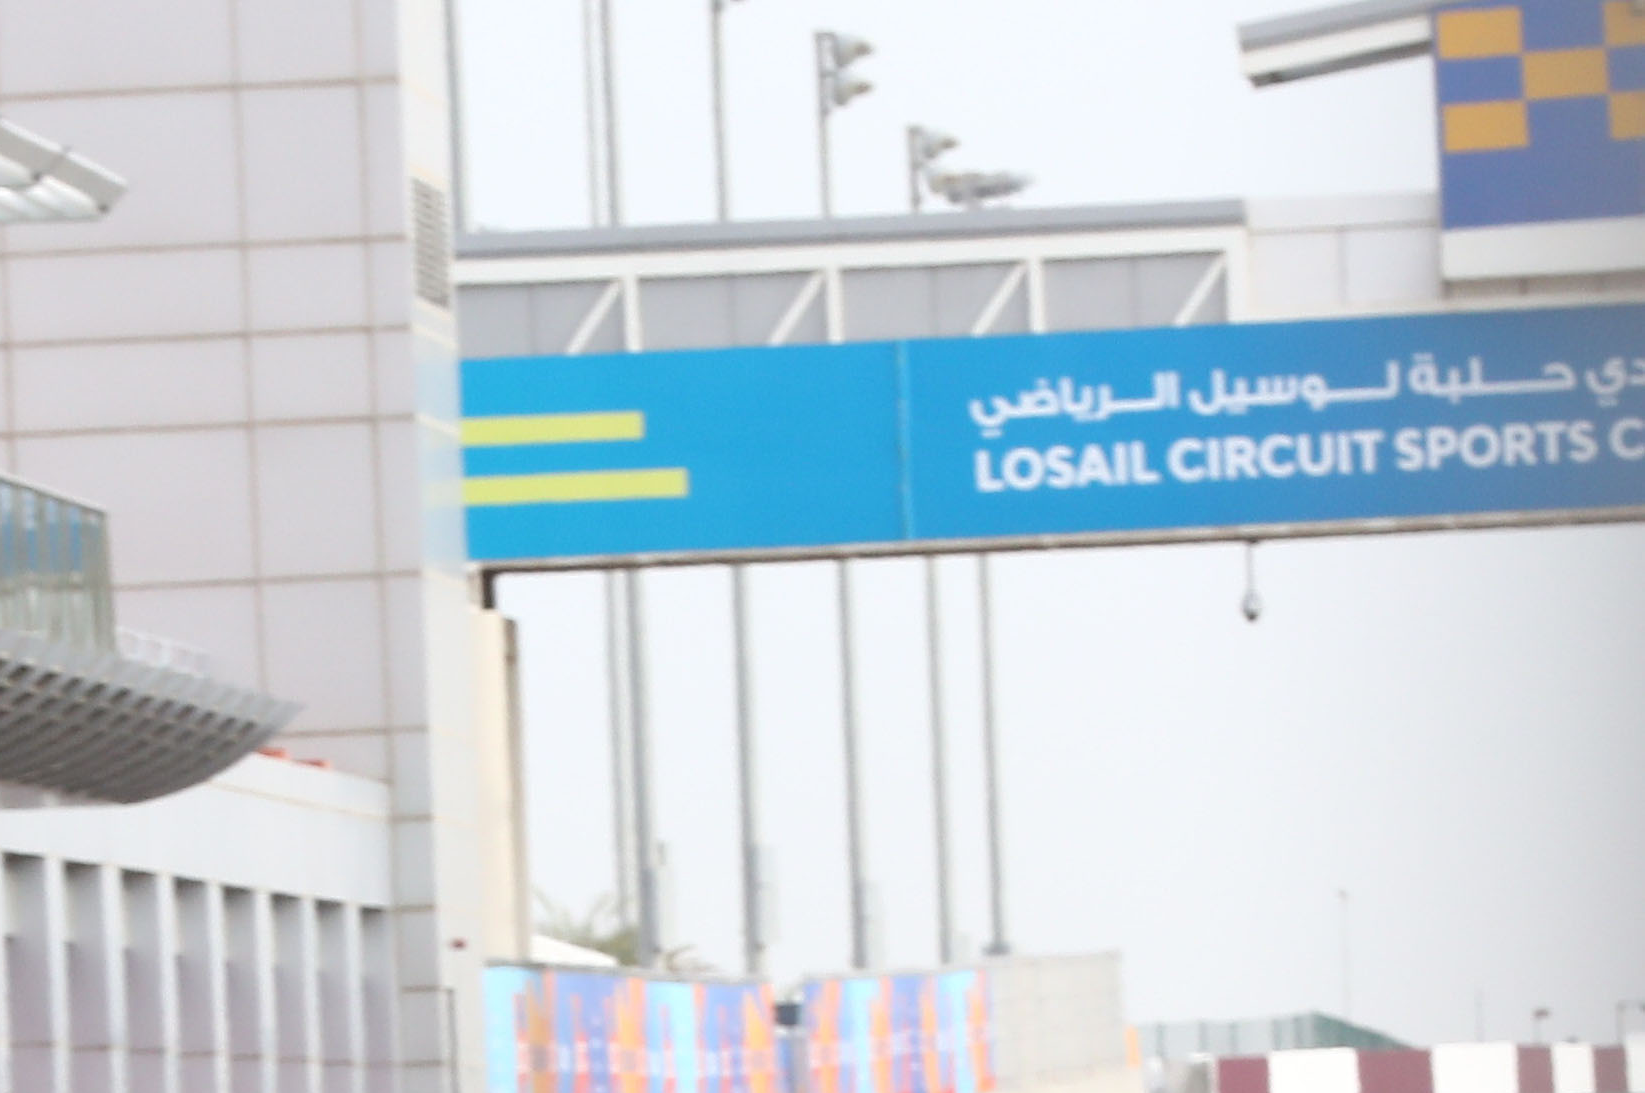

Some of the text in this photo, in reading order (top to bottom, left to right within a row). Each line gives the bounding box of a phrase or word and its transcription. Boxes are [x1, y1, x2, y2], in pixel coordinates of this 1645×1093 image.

[968, 369, 1182, 439] الرياضي
[973, 440, 1162, 493] LOSAIL
[1166, 427, 1385, 483] CIRCUIT
[1392, 418, 1599, 473] SPORTS
